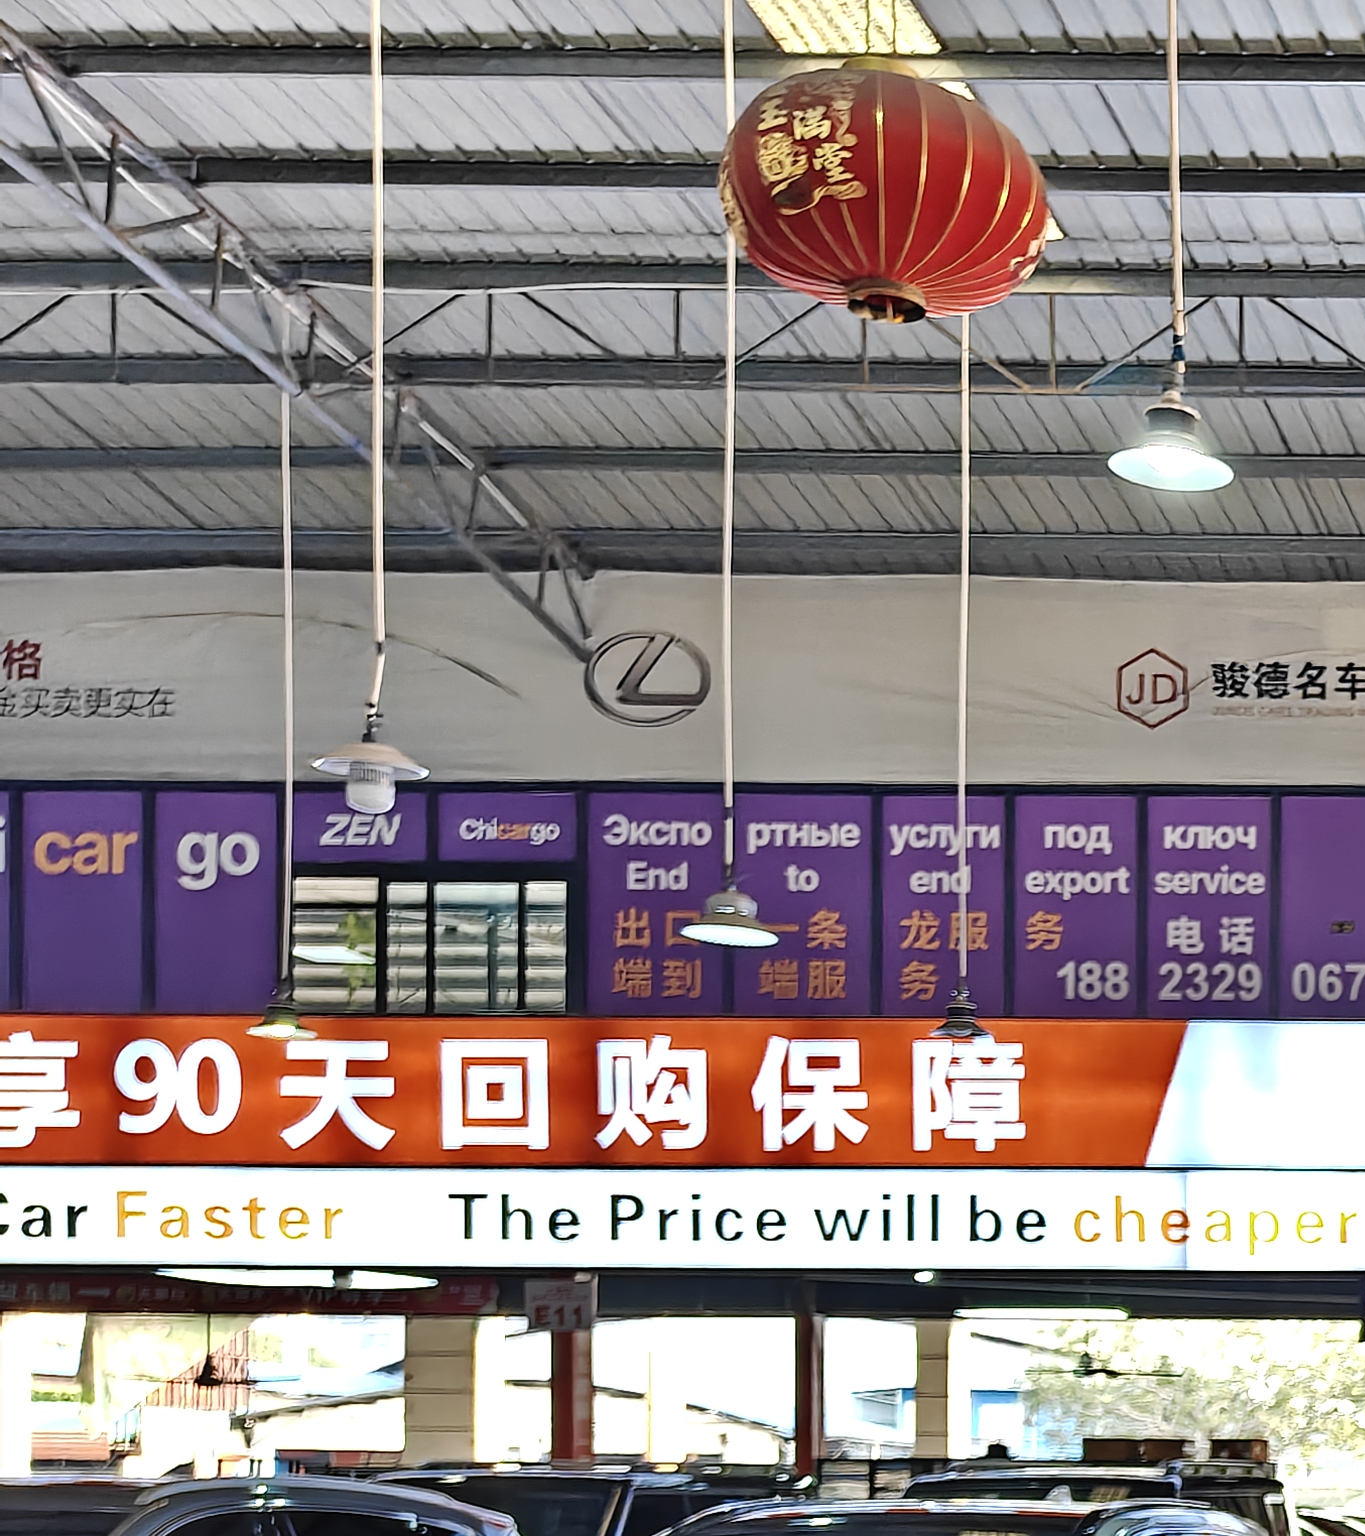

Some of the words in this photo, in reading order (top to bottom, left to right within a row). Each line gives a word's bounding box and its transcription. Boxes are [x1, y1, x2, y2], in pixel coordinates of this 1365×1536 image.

[1125, 673, 1178, 705] JD
[319, 812, 402, 846] ZEN
[459, 817, 561, 845] Chicargo
[890, 823, 1000, 856] услуги
[1044, 823, 1112, 856] под
[1163, 825, 1257, 851] ключ
[34, 831, 139, 875] car
[176, 830, 260, 890] go
[627, 861, 689, 892] End
[785, 864, 820, 893] to
[909, 865, 972, 894] end
[1025, 866, 1131, 900] export
[1154, 867, 1267, 897] service
[1166, 915, 1255, 956] 电话
[1057, 961, 1129, 1002] 188
[1157, 961, 1264, 1002] 2329
[0, 1193, 88, 1238] ar
[117, 1191, 343, 1240] Faster
[448, 1194, 580, 1241] The
[611, 1195, 786, 1241] Price
[814, 1194, 939, 1241] will
[970, 1195, 1046, 1242] be
[1074, 1195, 1357, 1256] cheaper
[534, 1304, 583, 1325] E11
